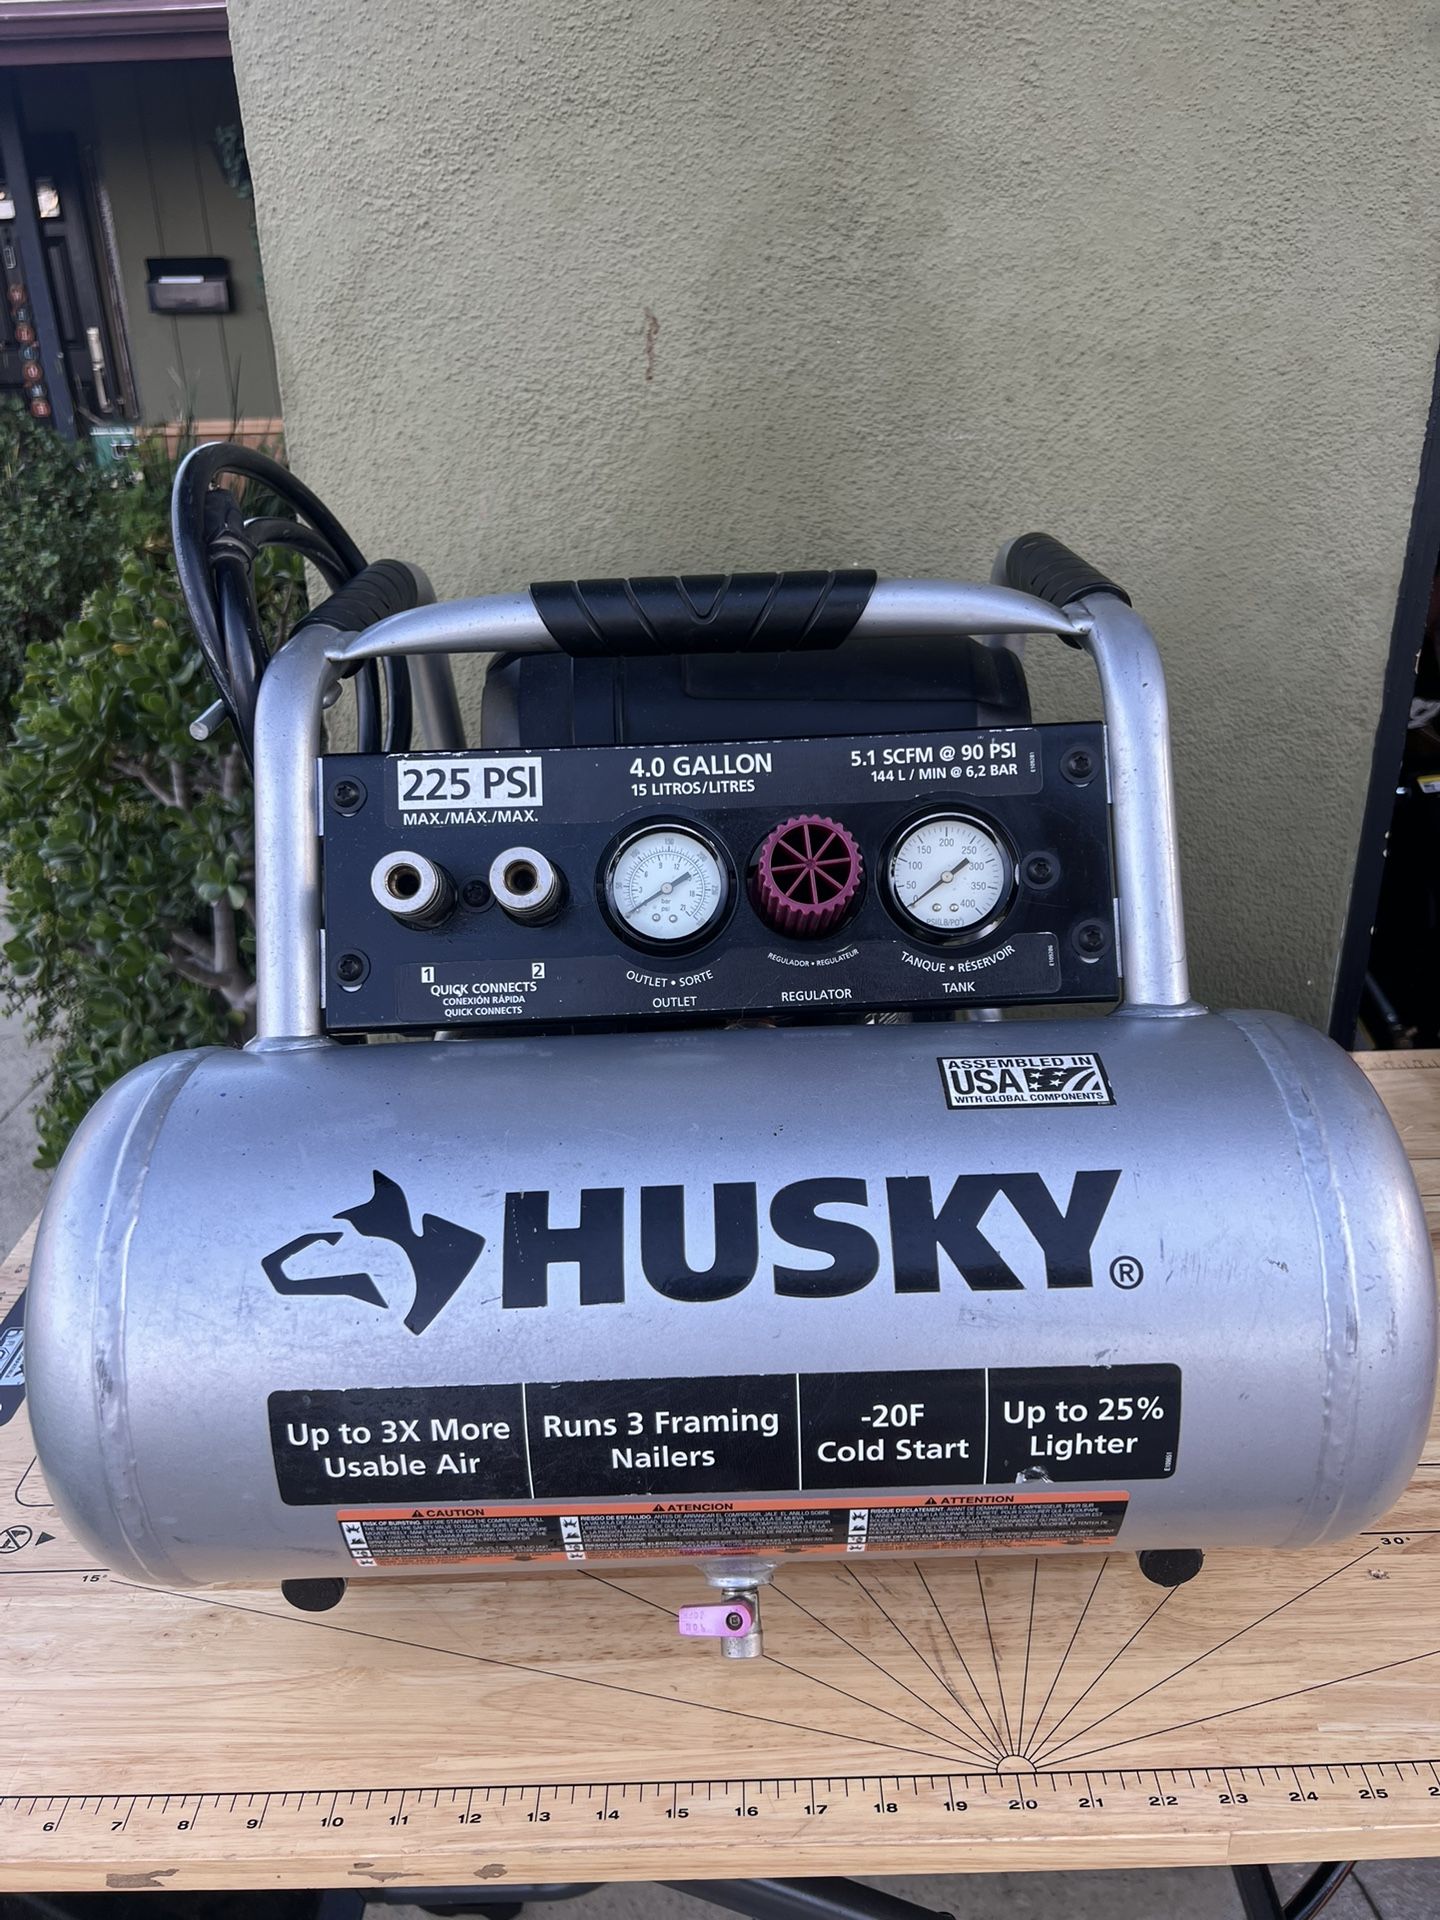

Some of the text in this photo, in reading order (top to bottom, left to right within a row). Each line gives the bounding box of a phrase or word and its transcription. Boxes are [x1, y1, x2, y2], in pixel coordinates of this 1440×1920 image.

[852, 742, 1016, 766] 5.1 SCFM @ 90 PSI
[630, 753, 772, 777] 4.0 GALLON
[871, 764, 1018, 782] 144 L / MIN @ 6,2 BAR
[403, 766, 536, 800] 225 PSI
[631, 780, 755, 796] 15 LITROS/LITRES
[403, 809, 538, 825] MAX./MÁX./MAX.
[940, 838, 954, 846] 200
[918, 846, 931, 854] 150
[962, 846, 976, 854] 250
[909, 862, 922, 870] 100
[907, 881, 916, 889] 50
[971, 882, 986, 890] 350
[960, 899, 975, 907] 400
[768, 948, 859, 967] REGULADOR REGULATEUR
[900, 944, 1015, 973] TANQUE RÉSERVOIR
[423, 968, 432, 982] 1
[533, 964, 543, 978] 2
[626, 969, 713, 988] OUTLET SORTE
[431, 982, 537, 996] QUICK CONNECTS
[782, 988, 852, 1002] REGULATOR
[942, 982, 975, 993] TANK
[443, 995, 525, 1006] CONEXIÓN RÁPIDA
[653, 996, 697, 1008] OUTLET
[445, 1006, 522, 1017] QUICK CONNECTS
[948, 1056, 1092, 1069] ASSEMBLED IN
[951, 1069, 1024, 1095] USA
[955, 1092, 1103, 1104] WITH GLOBAL COMPONENTS
[502, 1170, 1122, 1308] HUSKY
[861, 1404, 925, 1428] -20F
[1004, 1396, 1164, 1428] Up to 25%
[544, 1409, 779, 1439] Runs 3 Framing
[287, 1418, 510, 1451] Up to 3X More
[818, 1437, 969, 1463] Cold Start
[1030, 1434, 1138, 1461] Lighter
[612, 1446, 716, 1469] Nailers
[325, 1453, 480, 1478] Usable Air
[941, 1495, 1014, 1504] ATTENTION
[426, 1508, 484, 1518] CAUTION
[667, 1503, 733, 1512] ATENCION
[43, 1821, 54, 1831] 6
[111, 1821, 122, 1831] 7
[177, 1820, 189, 1830] 8
[246, 1819, 259, 1829] 9
[321, 1817, 344, 1827] 10
[389, 1816, 409, 1825] 11
[458, 1814, 482, 1824] 12
[527, 1812, 550, 1822] 13
[596, 1810, 620, 1820] 14
[666, 1808, 689, 1818] 15
[735, 1806, 758, 1816] 16
[804, 1805, 828, 1815] 17
[874, 1803, 898, 1813] 18
[944, 1802, 967, 1811] 19
[1009, 1800, 1038, 1810] 20
[1079, 1798, 1103, 1808] 21
[1149, 1796, 1178, 1806] 22
[1219, 1794, 1248, 1803] 23
[1289, 1792, 1318, 1801] 24
[1359, 1789, 1388, 1799] 25
